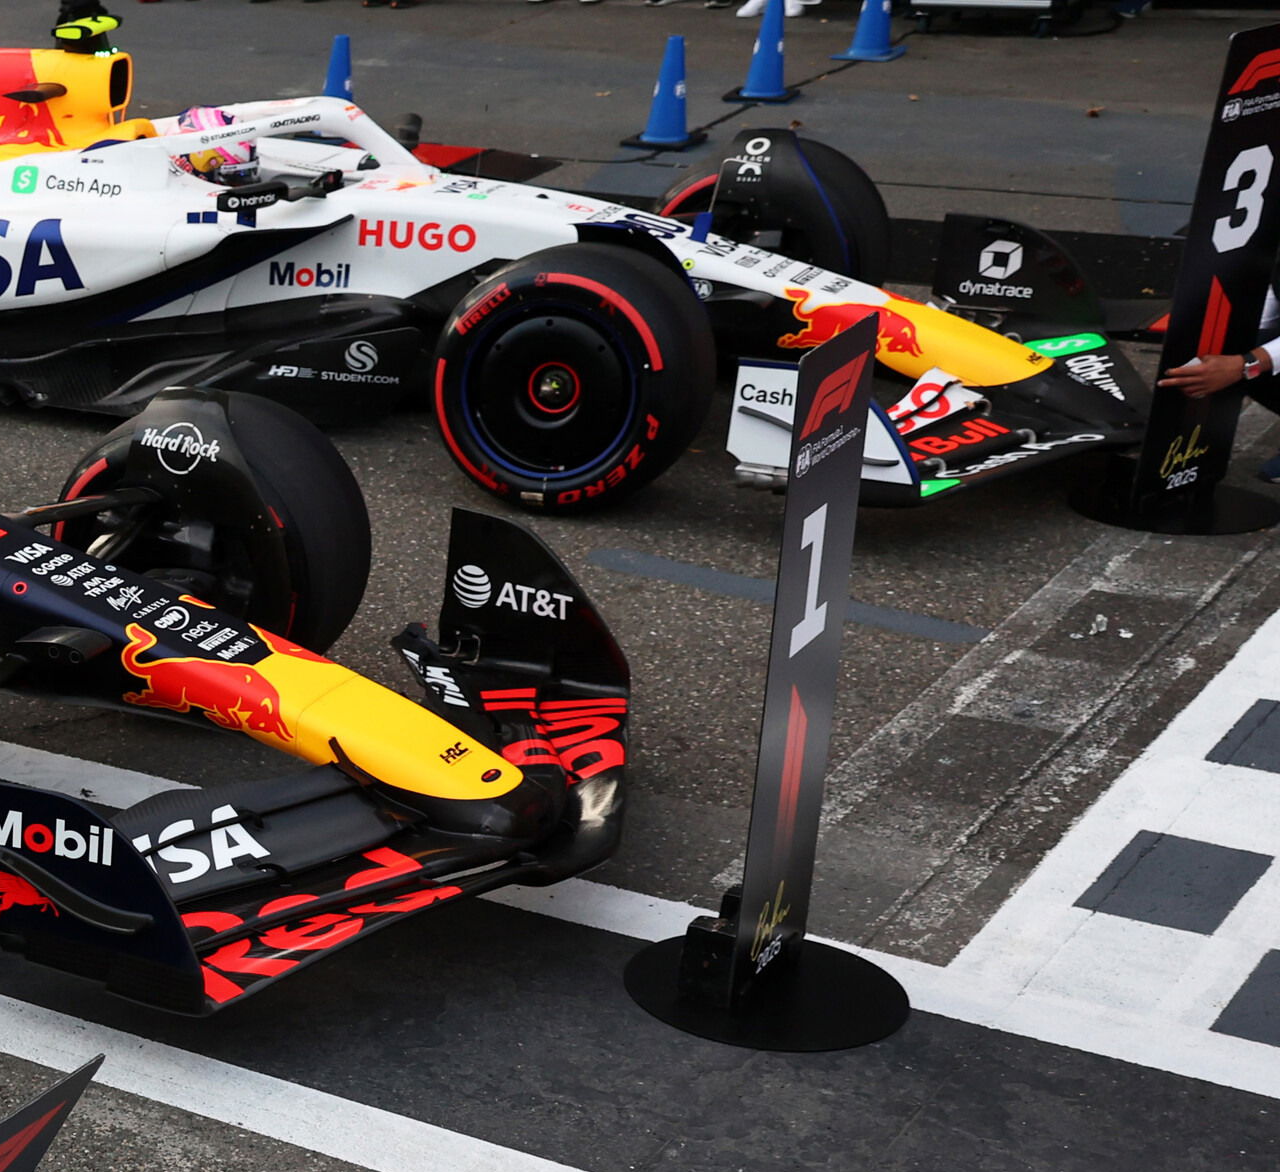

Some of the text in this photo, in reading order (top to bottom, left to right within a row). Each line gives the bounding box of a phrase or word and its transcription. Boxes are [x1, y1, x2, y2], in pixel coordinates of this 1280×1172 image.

[45, 175, 122, 198] Cash App
[1212, 145, 1274, 253] 3
[357, 219, 477, 254] HUGO
[269, 262, 350, 289] Mobil
[959, 280, 1033, 300] dynatrace
[455, 282, 512, 335] PIRELLI
[321, 371, 400, 384] STUDENT.COM
[740, 383, 794, 408] Cash
[141, 428, 220, 462] Hard Rock
[556, 414, 661, 504] P ZERO
[1166, 467, 1198, 490] 2025
[5, 542, 53, 564] VISA
[67, 562, 97, 580] AT&T
[789, 503, 828, 659] 1
[85, 577, 125, 598] TRADE
[132, 598, 170, 619] CARLYLE
[495, 581, 574, 621] AT&T
[154, 611, 183, 629] CDW
[198, 628, 239, 651] PIRELLI
[217, 640, 249, 660] Mobil
